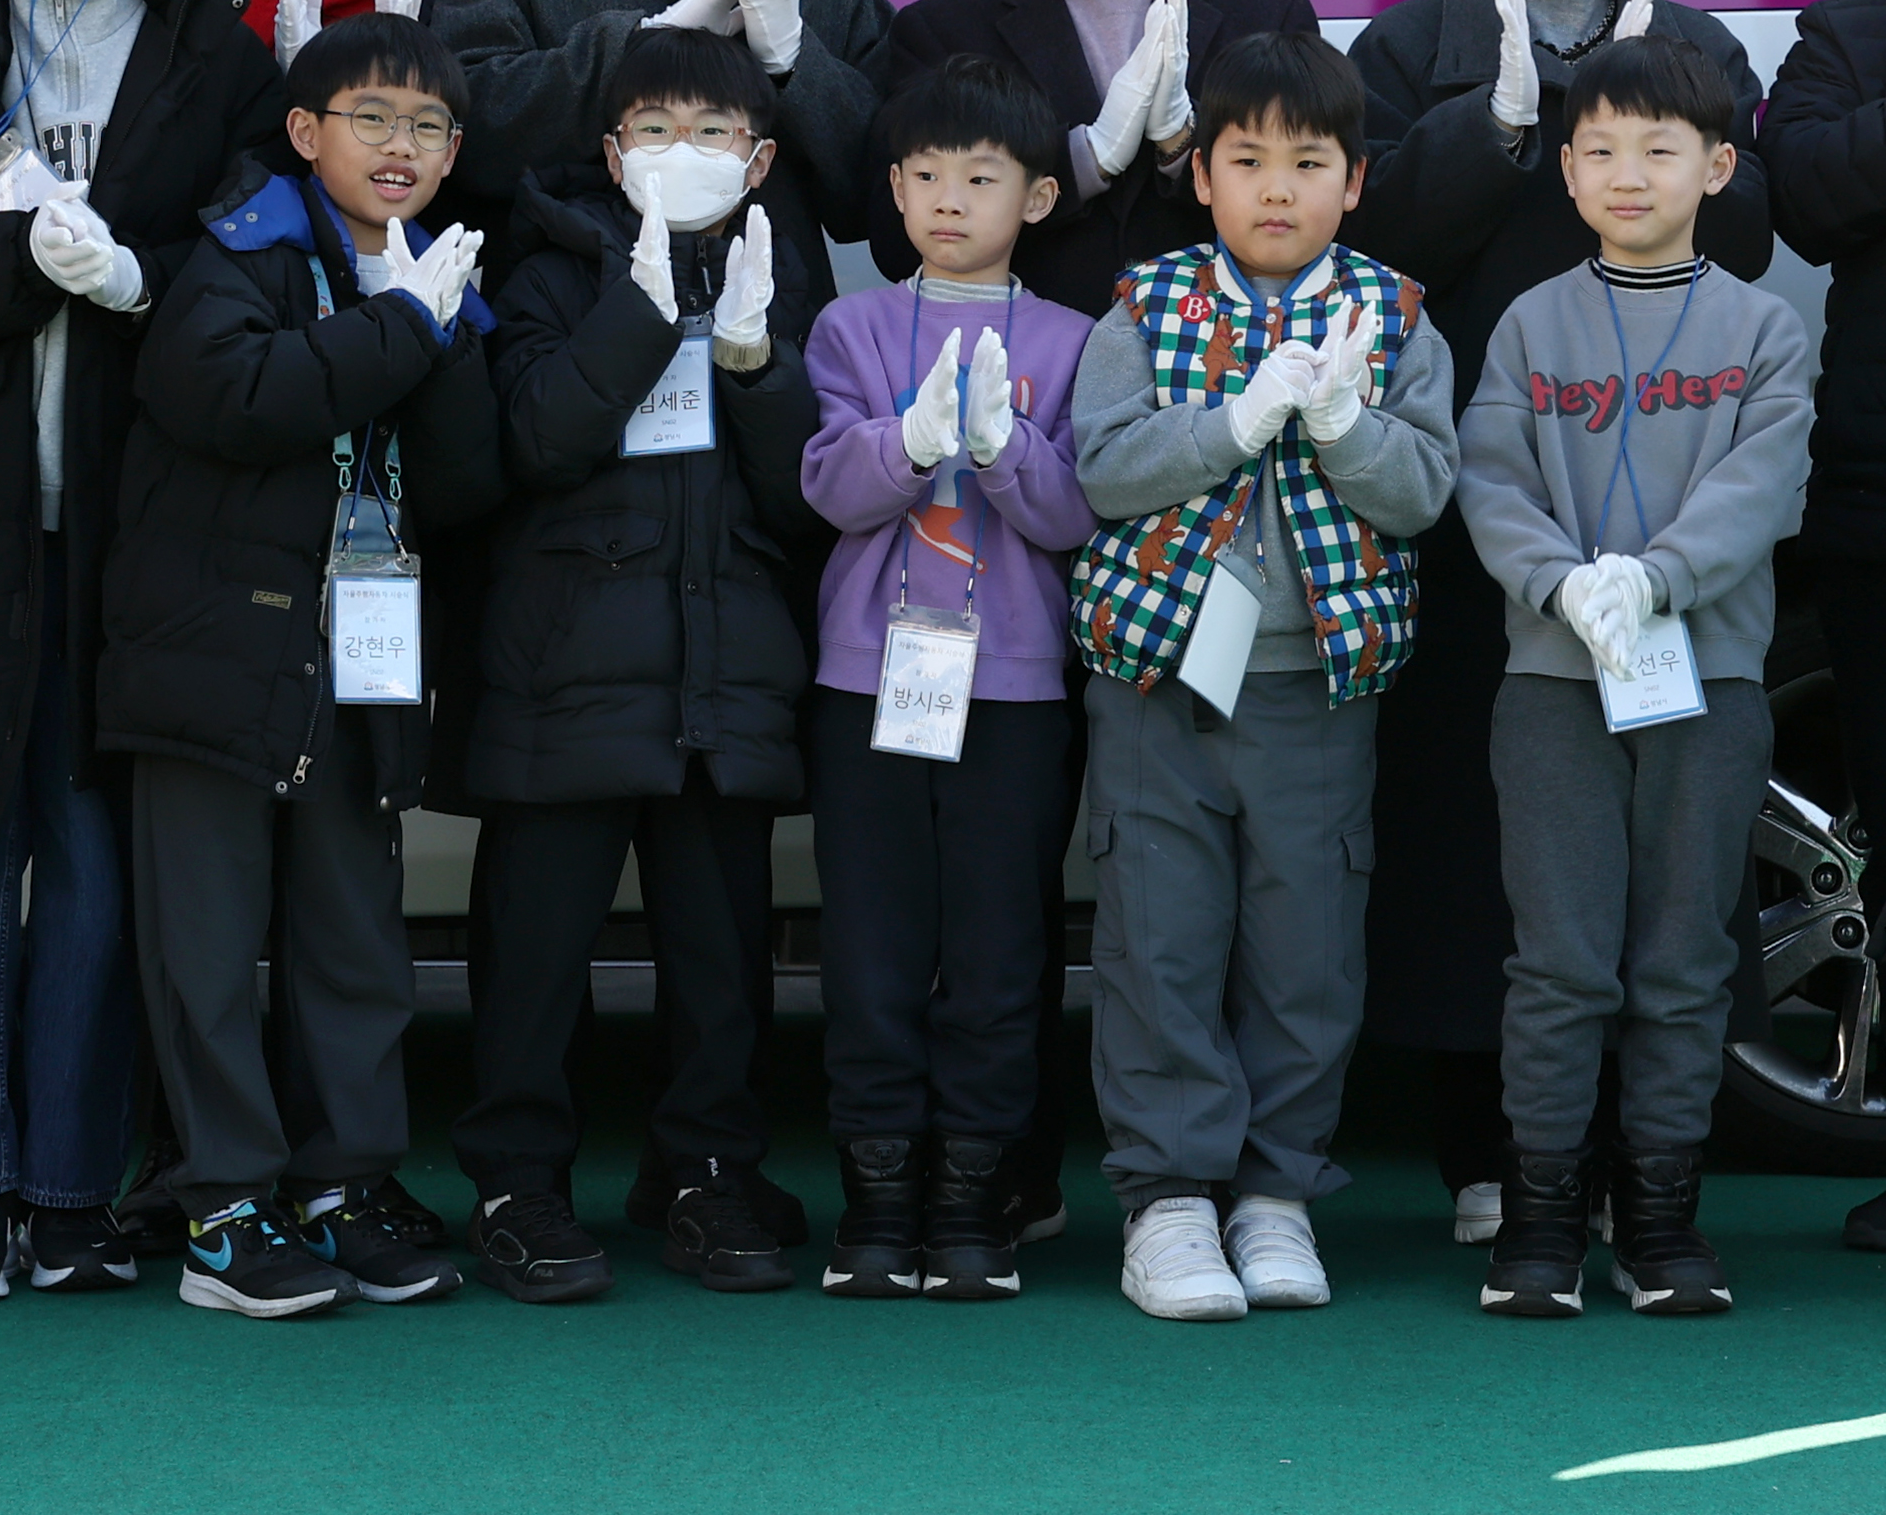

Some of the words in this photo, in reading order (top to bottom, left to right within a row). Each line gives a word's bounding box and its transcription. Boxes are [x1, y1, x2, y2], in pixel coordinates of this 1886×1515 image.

[1530, 371, 1625, 434] Hey
[344, 636, 406, 659] 강현우
[1629, 650, 1680, 676] 선우
[894, 686, 954, 717] 방시우
